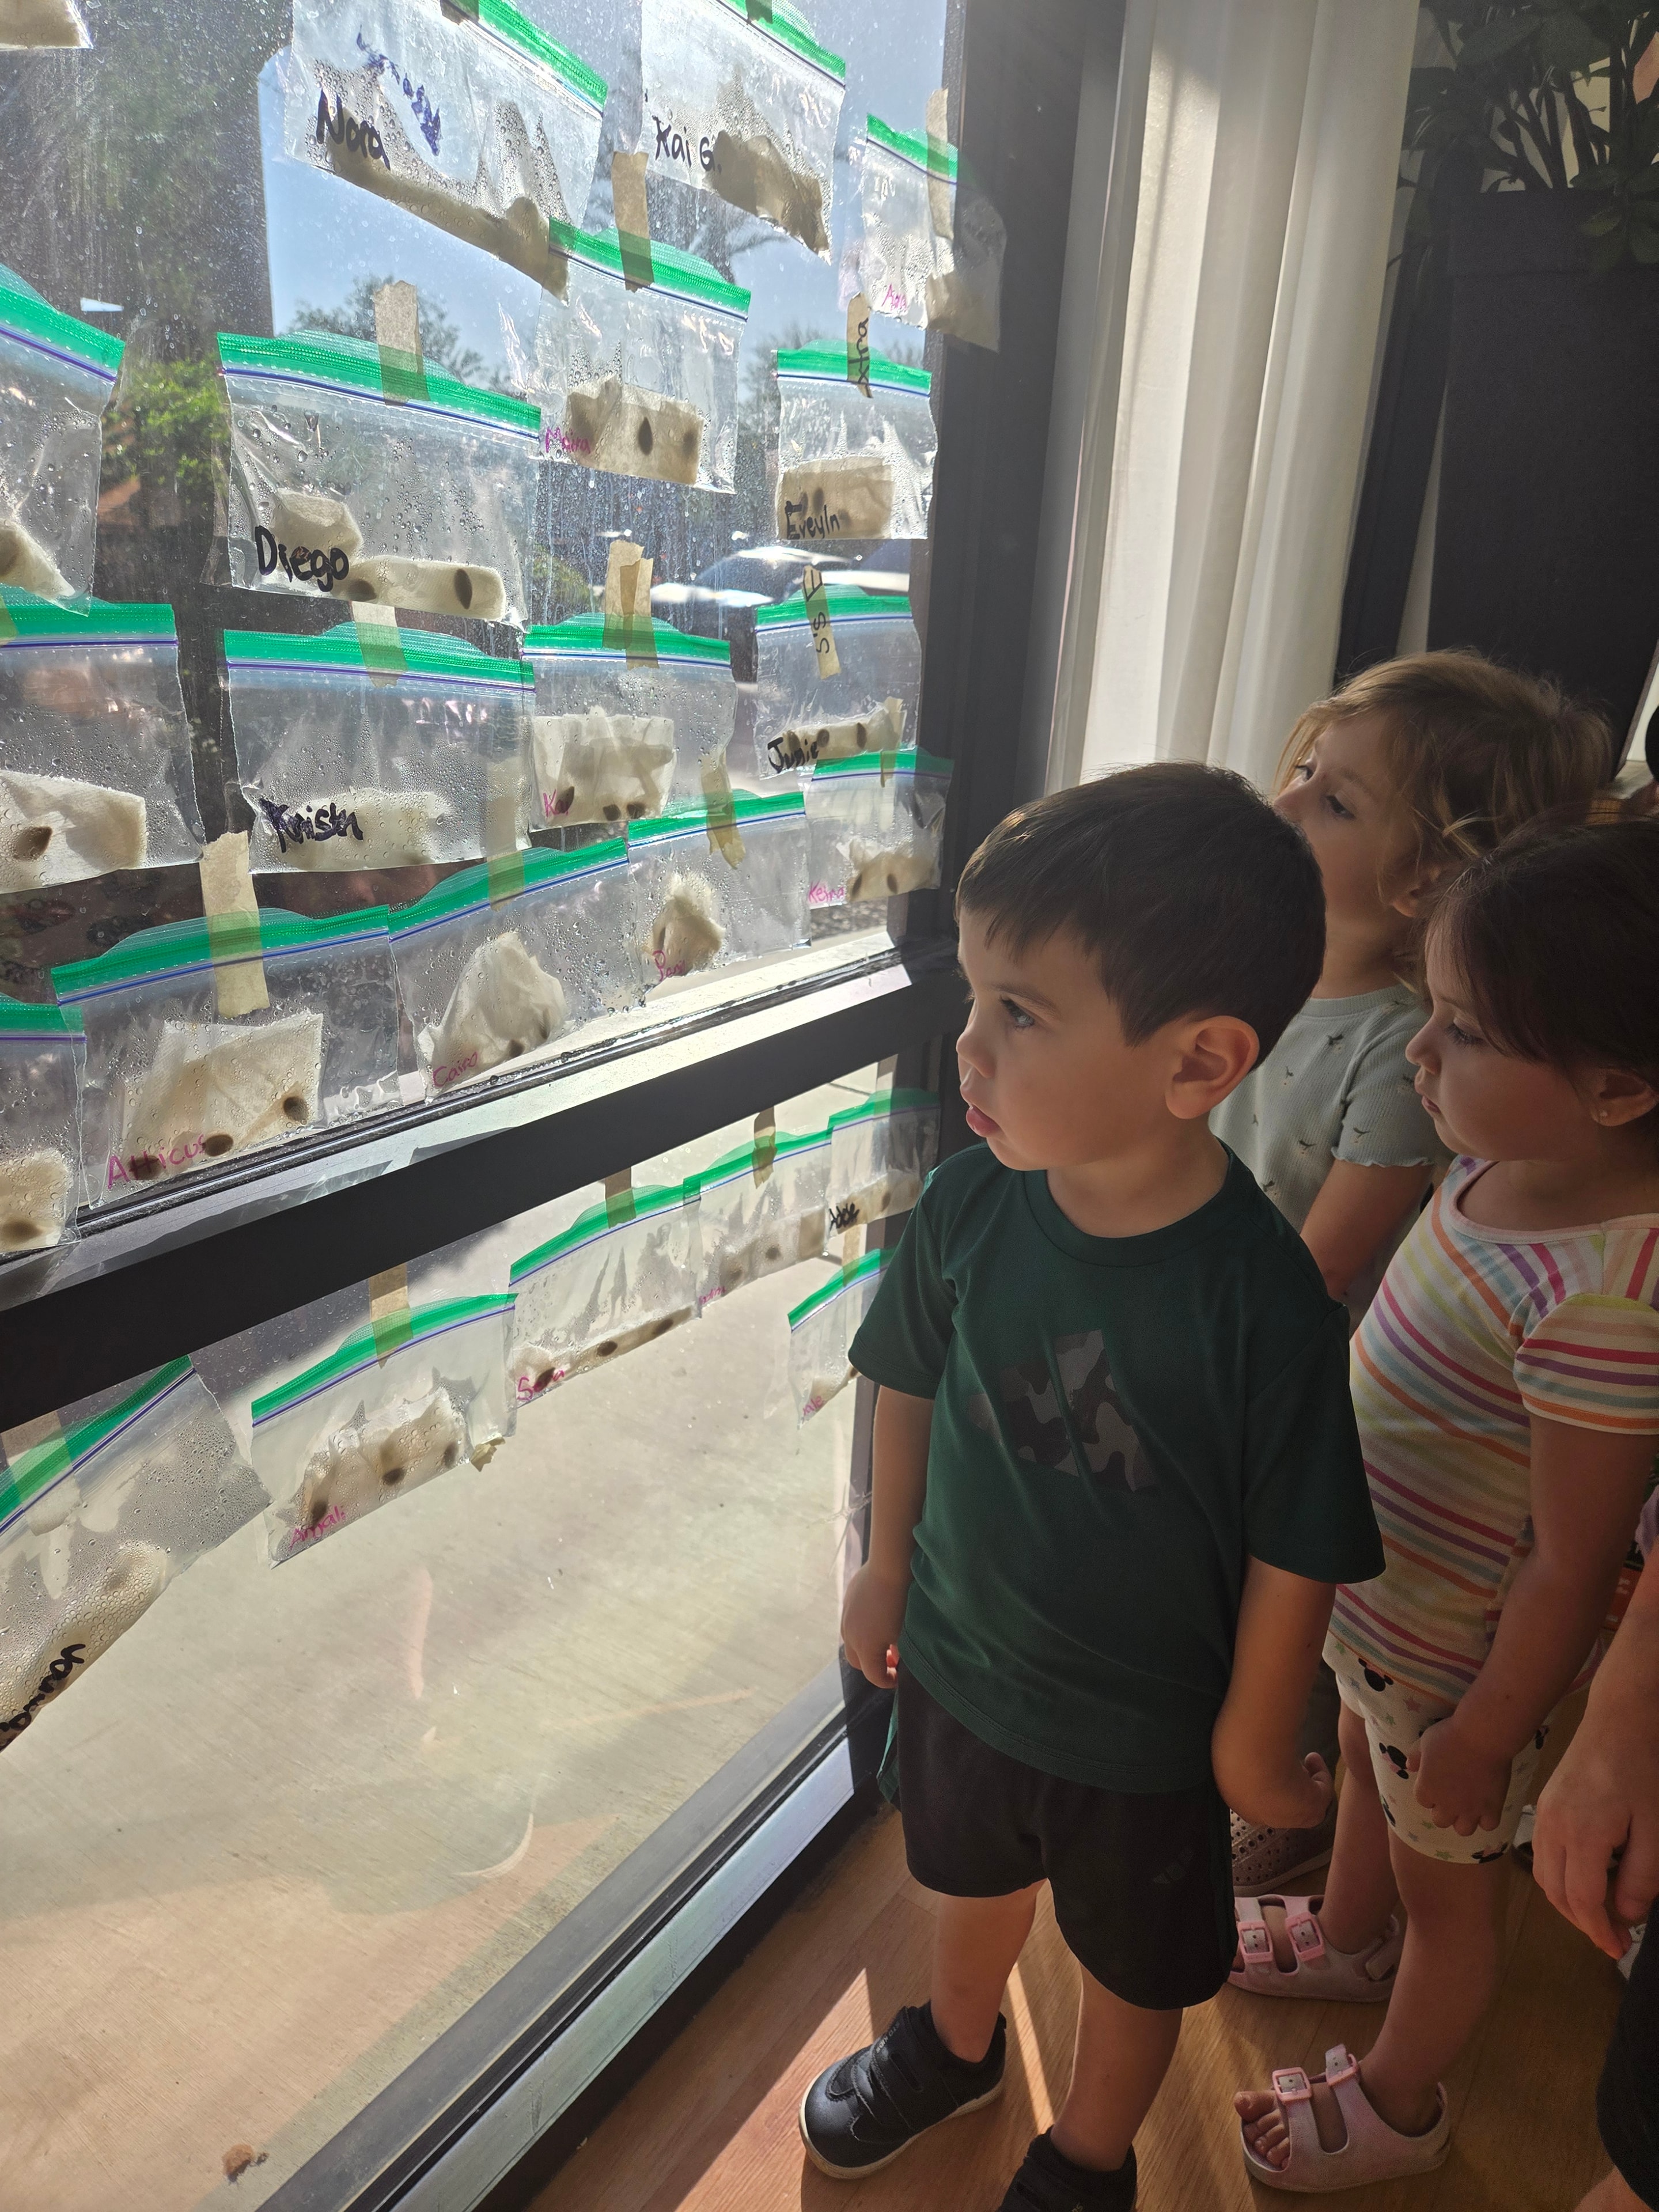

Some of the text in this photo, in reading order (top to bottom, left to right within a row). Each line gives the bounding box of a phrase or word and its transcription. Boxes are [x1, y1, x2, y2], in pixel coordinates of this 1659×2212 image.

[316, 89, 391, 171] Nora
[652, 115, 691, 167] Kai
[254, 525, 350, 593] Diego
[432, 1051, 478, 1088] Cairo
[107, 1134, 206, 1190] Atticus
